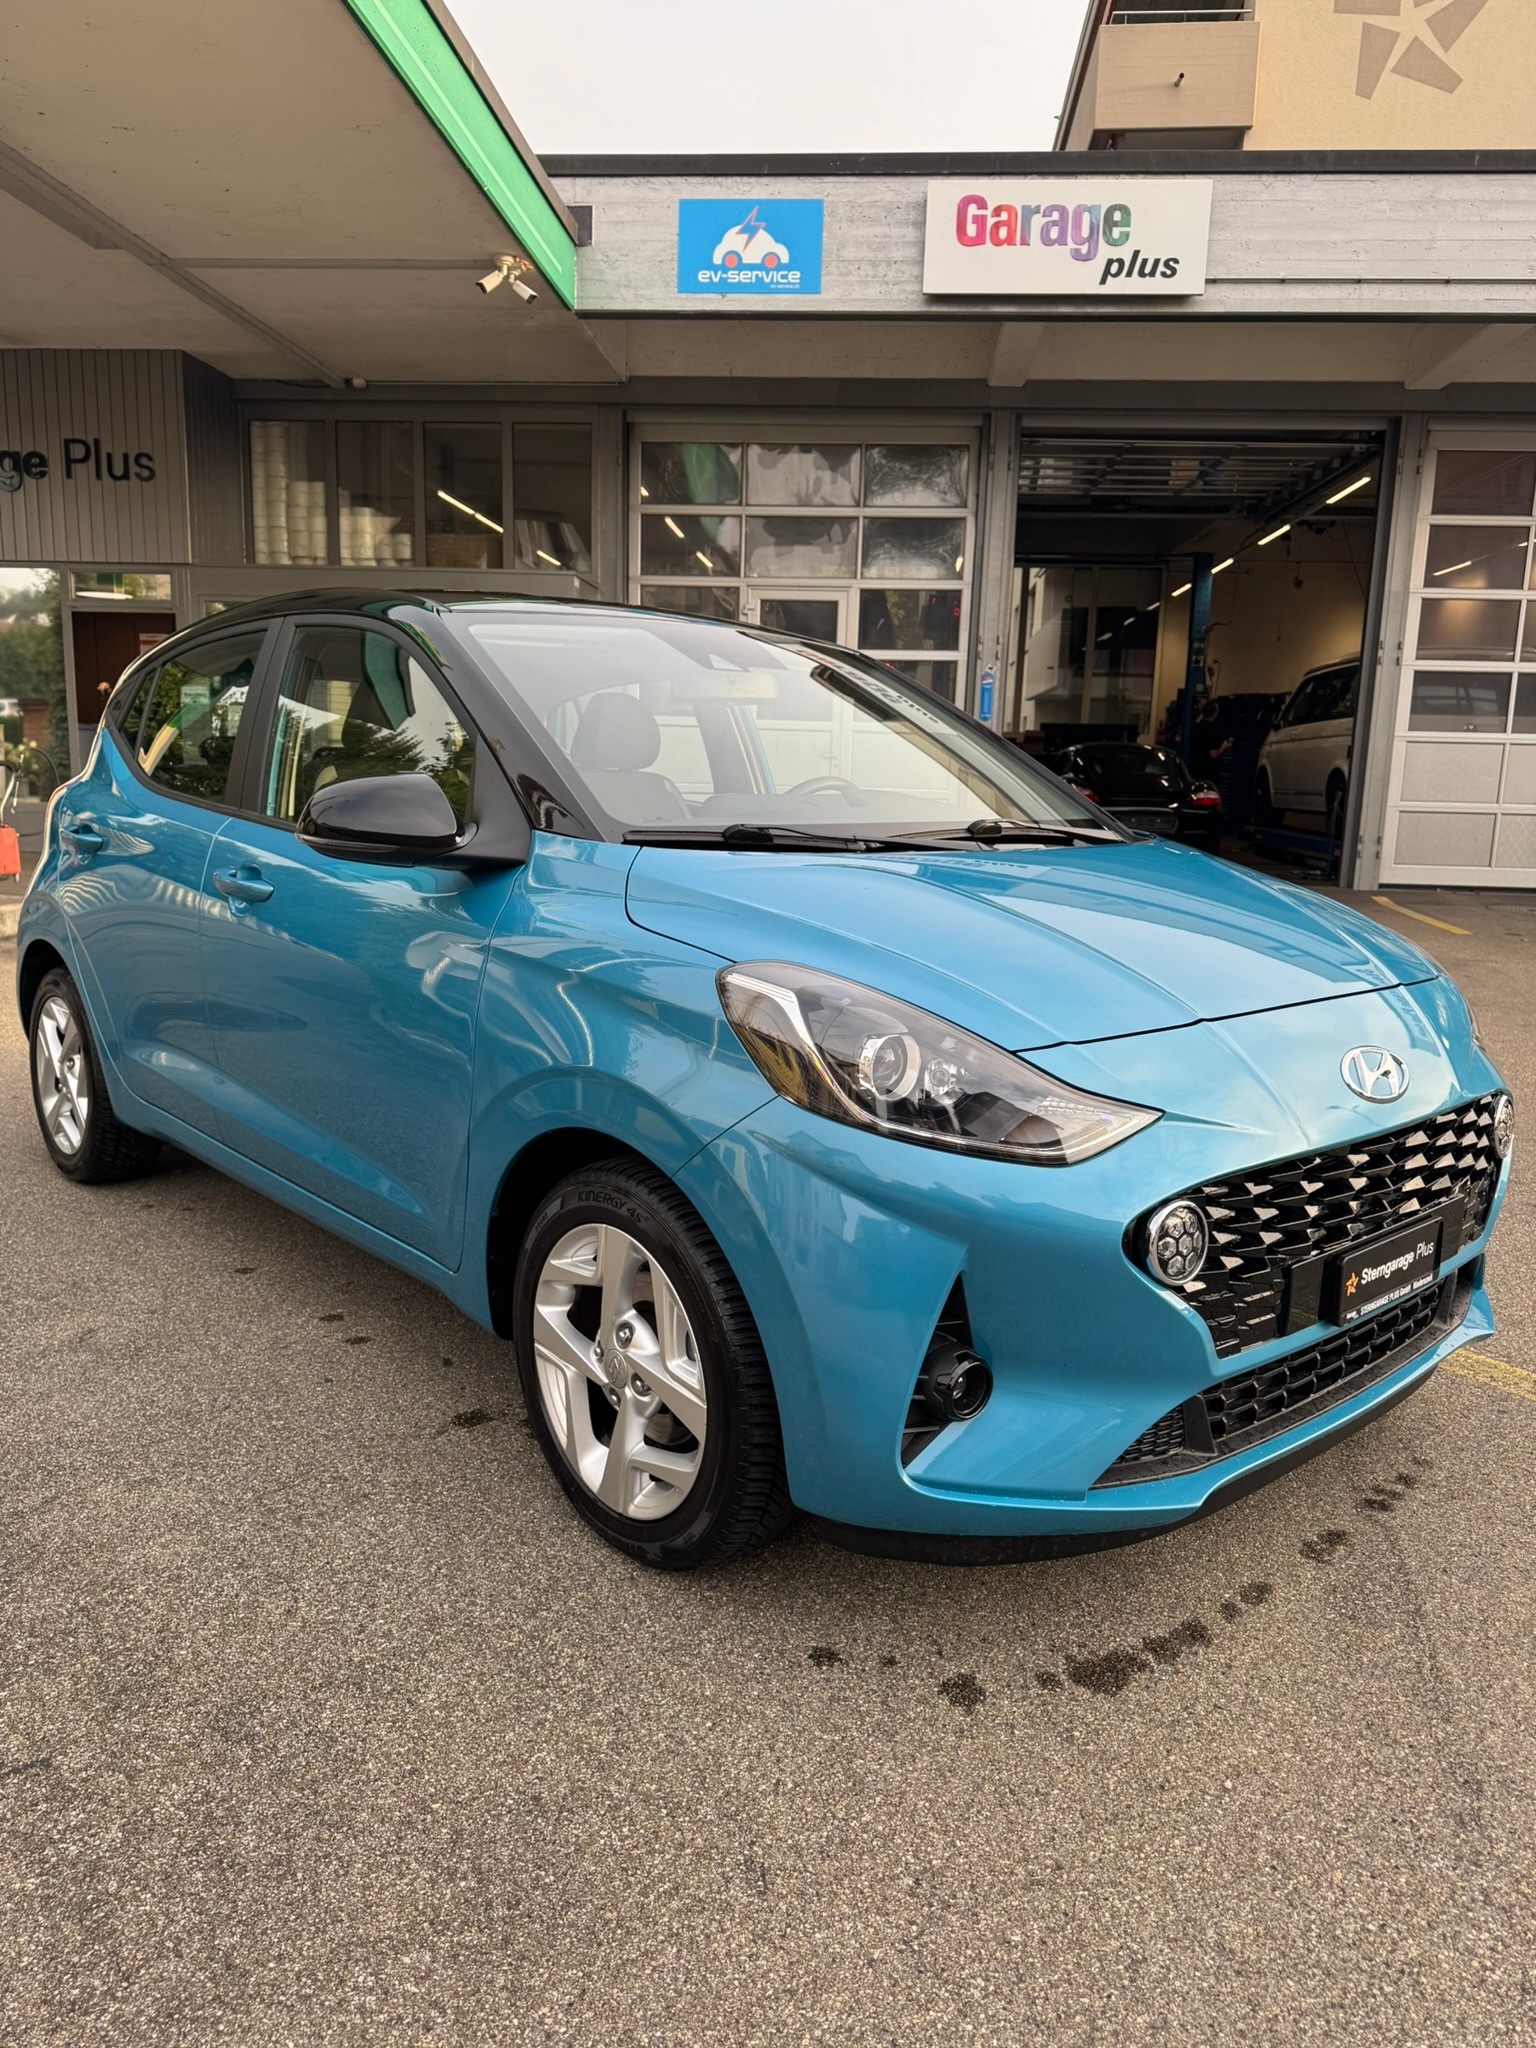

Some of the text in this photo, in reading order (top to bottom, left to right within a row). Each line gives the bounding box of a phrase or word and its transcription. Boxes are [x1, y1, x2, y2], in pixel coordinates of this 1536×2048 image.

[955, 194, 1132, 262] Garage
[697, 270, 801, 284] ev-service
[1099, 249, 1181, 286] plus
[63, 437, 156, 482] Plus
[1361, 1241, 1434, 1284] Sterngarage Plus
